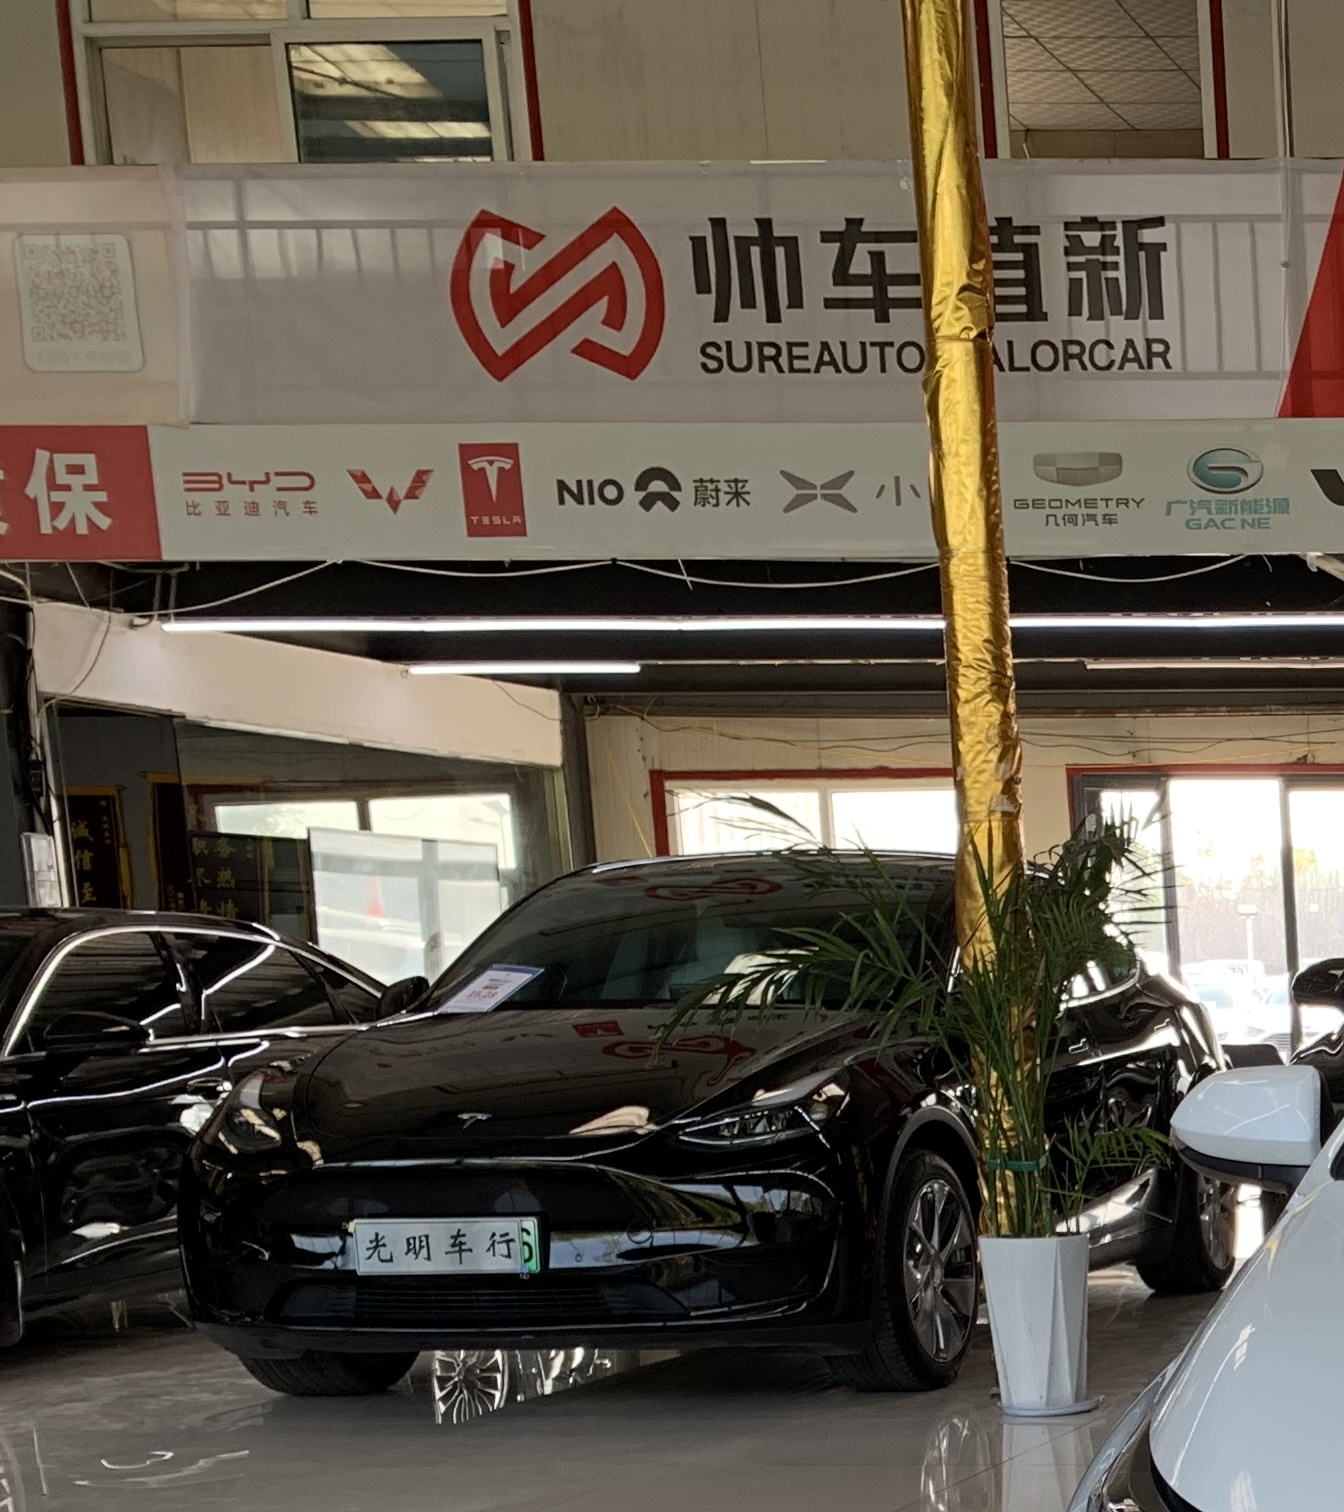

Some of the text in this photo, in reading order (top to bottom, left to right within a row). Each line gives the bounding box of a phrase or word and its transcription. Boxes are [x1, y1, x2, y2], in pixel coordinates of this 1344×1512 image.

[0, 447, 113, 535] 保
[182, 471, 316, 492] BYD
[875, 475, 921, 507] 小
[556, 477, 751, 508] NIO 蔚来
[185, 500, 319, 517] 比亚迪汽车
[1013, 498, 1145, 510] GEOMETRY
[1164, 497, 1291, 516] 广汽新能源
[470, 515, 522, 525] TESLA
[1045, 513, 1119, 527] 几何汽车
[364, 1228, 516, 1265] 光明车行
